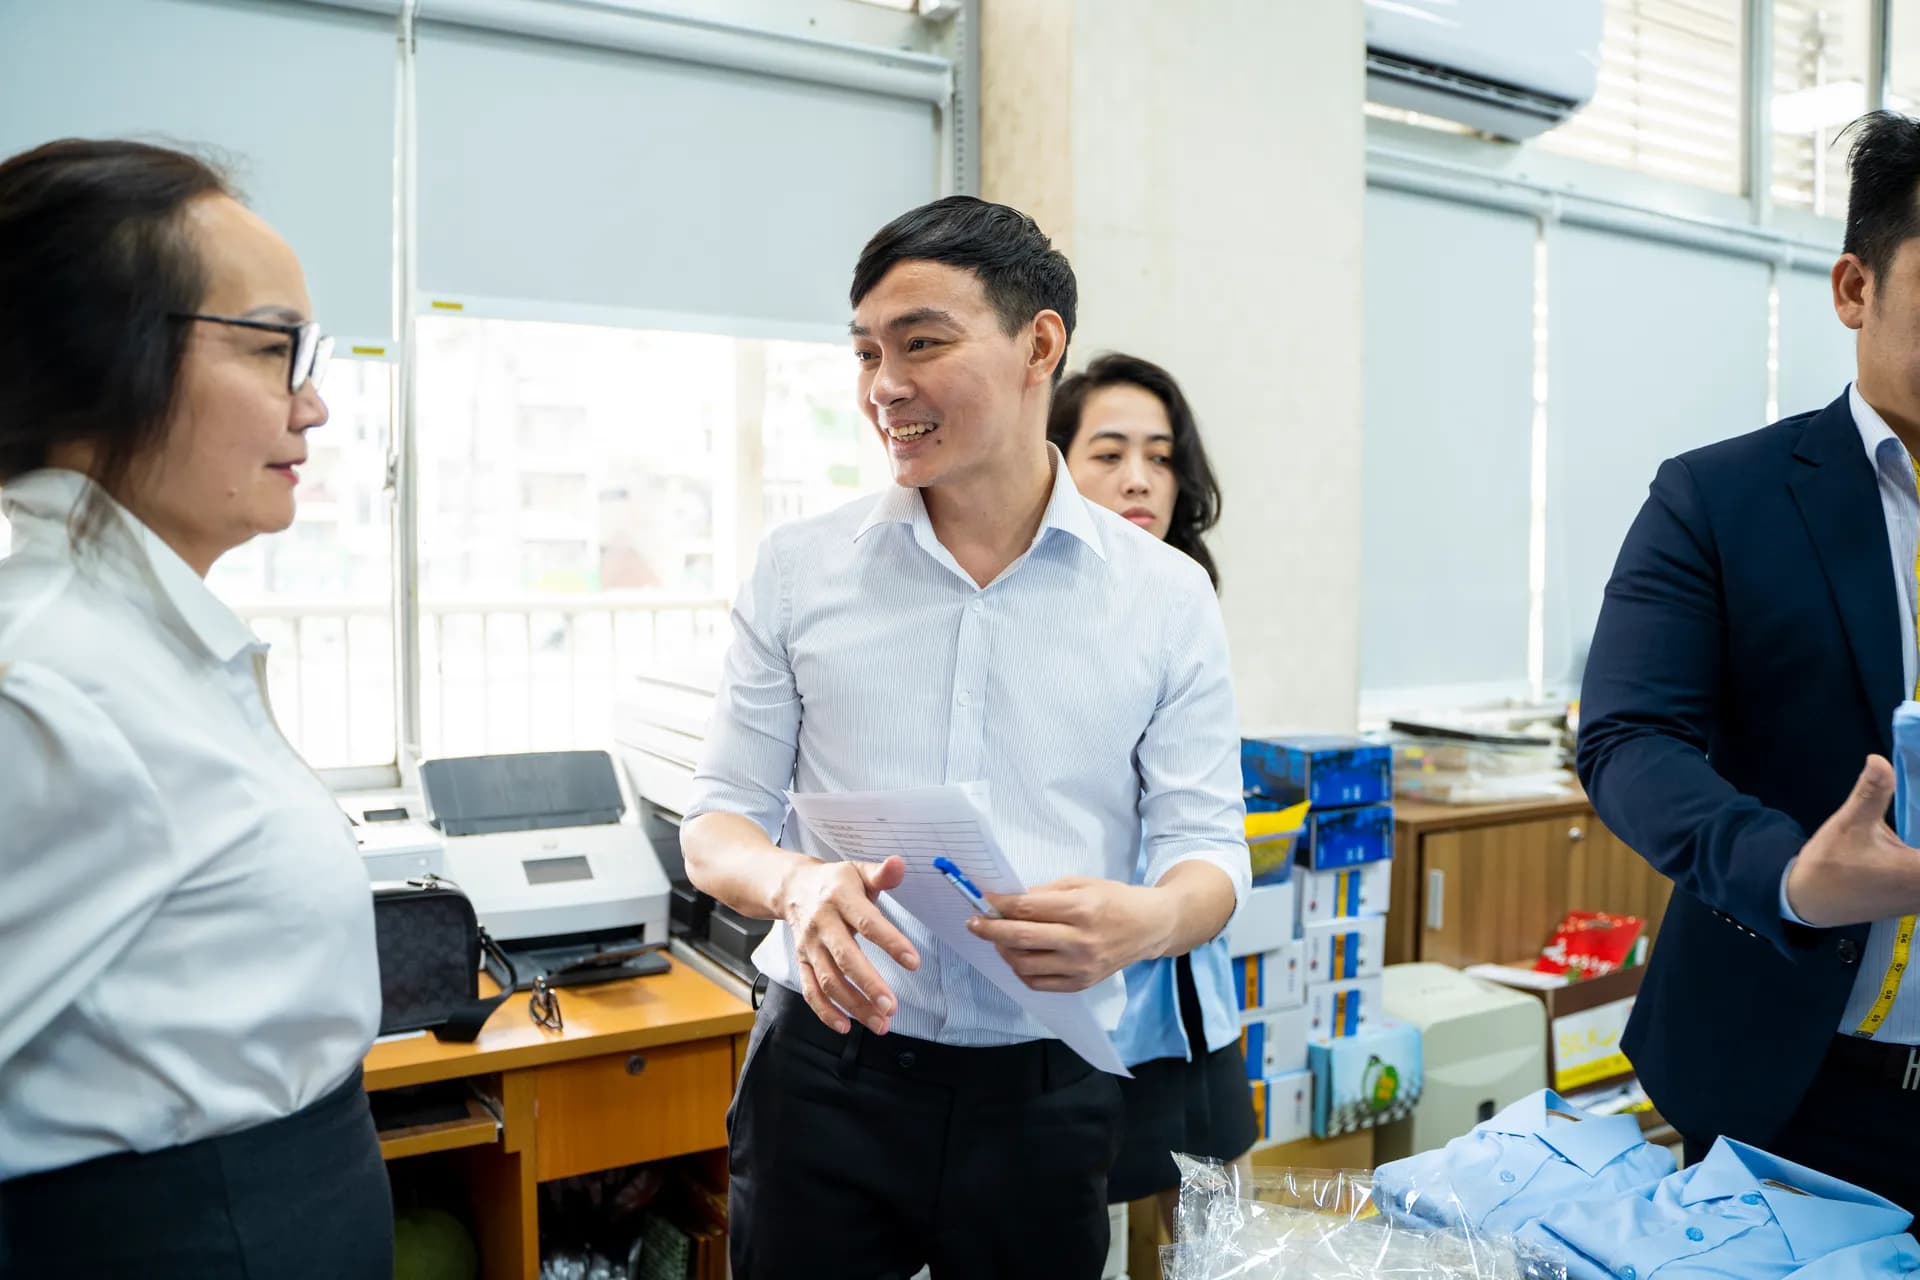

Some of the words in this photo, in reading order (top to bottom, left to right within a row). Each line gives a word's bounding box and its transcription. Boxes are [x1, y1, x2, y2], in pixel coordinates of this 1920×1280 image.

[1900, 933, 1909, 943] 56
[1894, 963, 1903, 972] 57
[1884, 990, 1893, 1000] 58
